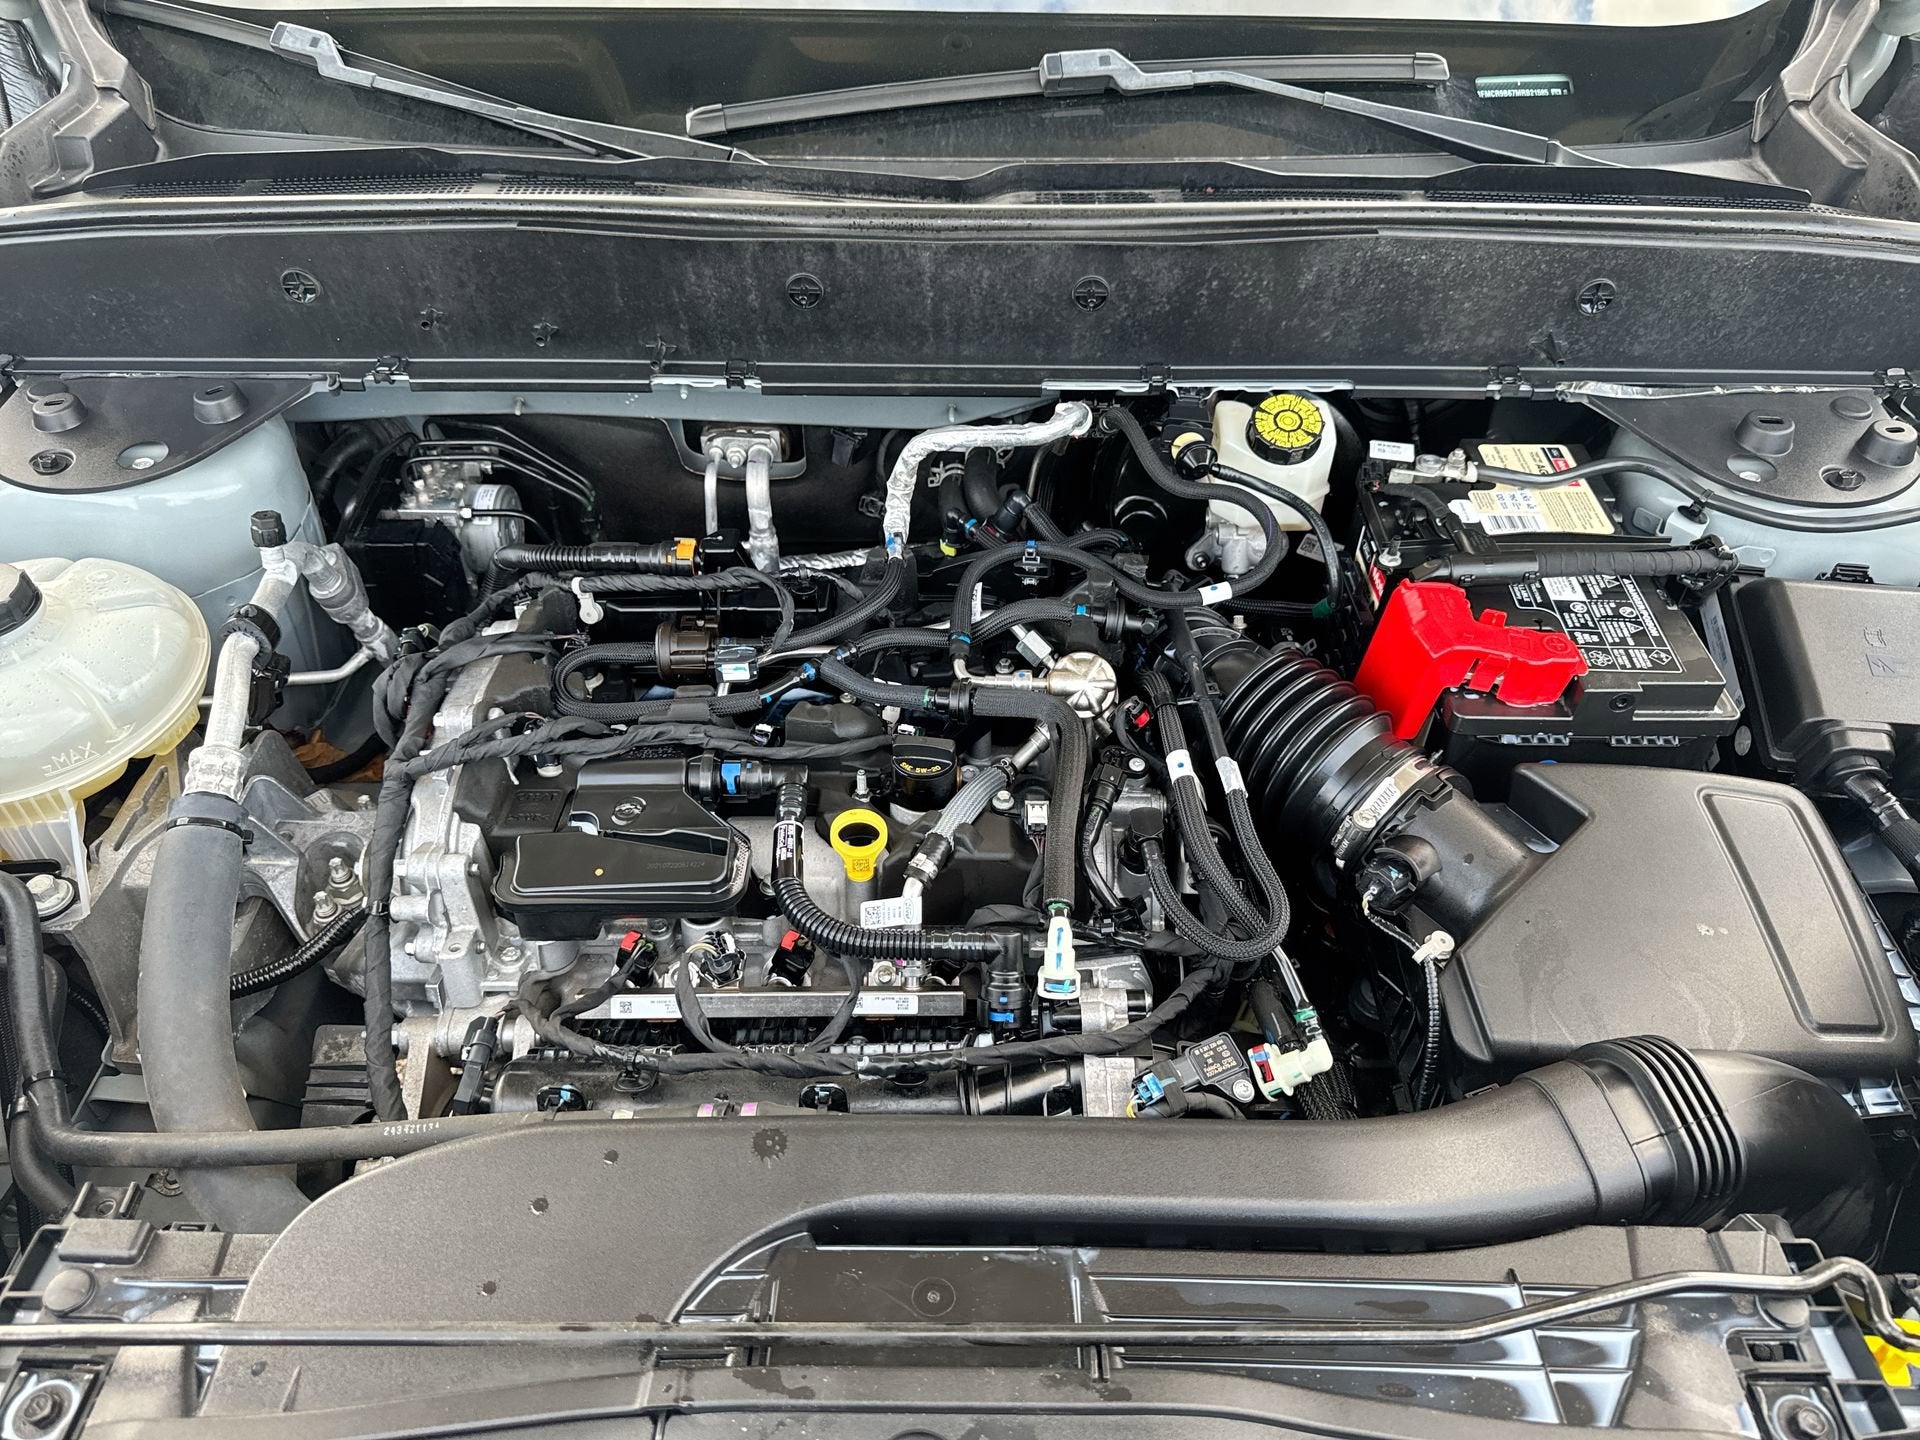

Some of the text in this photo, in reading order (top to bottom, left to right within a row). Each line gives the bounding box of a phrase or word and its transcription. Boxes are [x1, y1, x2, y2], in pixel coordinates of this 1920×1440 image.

[51, 741, 101, 769] MAX
[899, 761, 942, 774] SAE 5W-20
